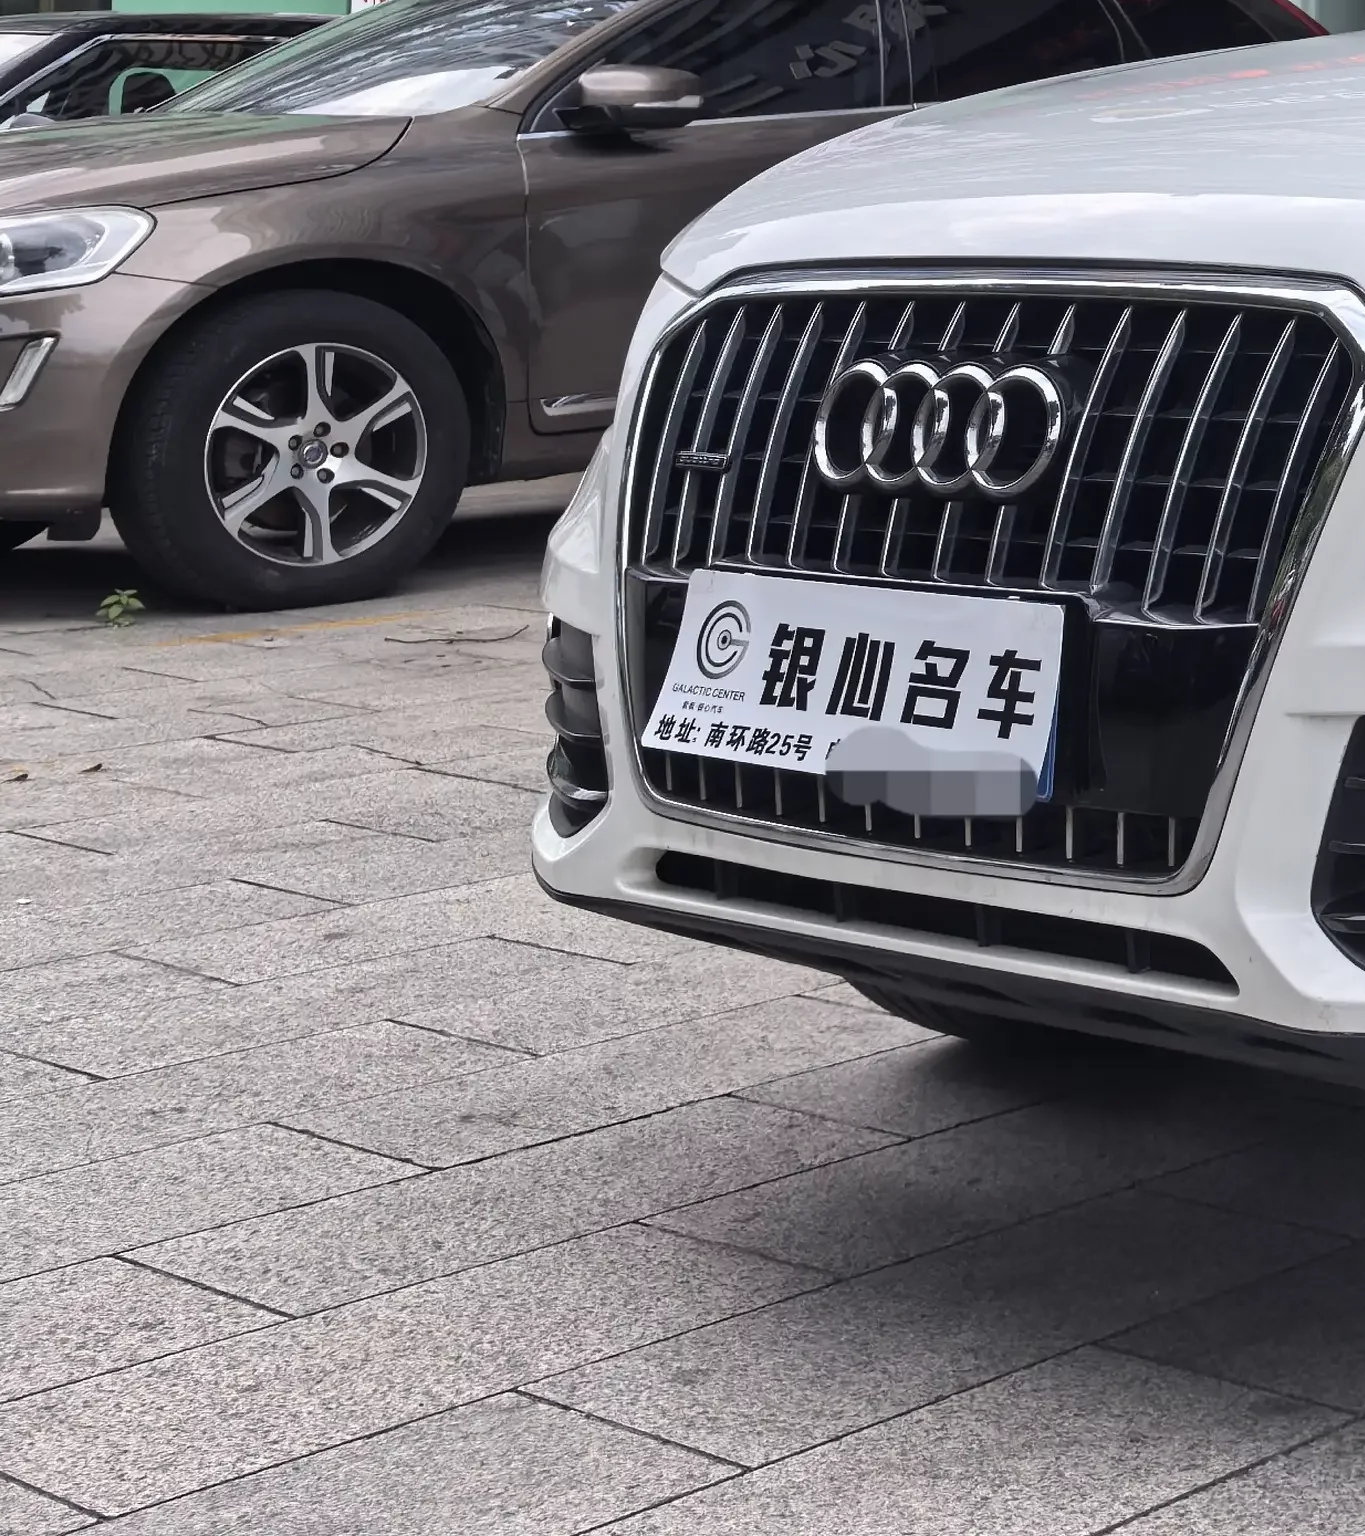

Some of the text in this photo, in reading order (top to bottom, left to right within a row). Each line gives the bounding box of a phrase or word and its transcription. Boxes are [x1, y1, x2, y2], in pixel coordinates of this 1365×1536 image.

[672, 682, 746, 703] GALACTIC CENTER
[758, 622, 1043, 740] 银心名车
